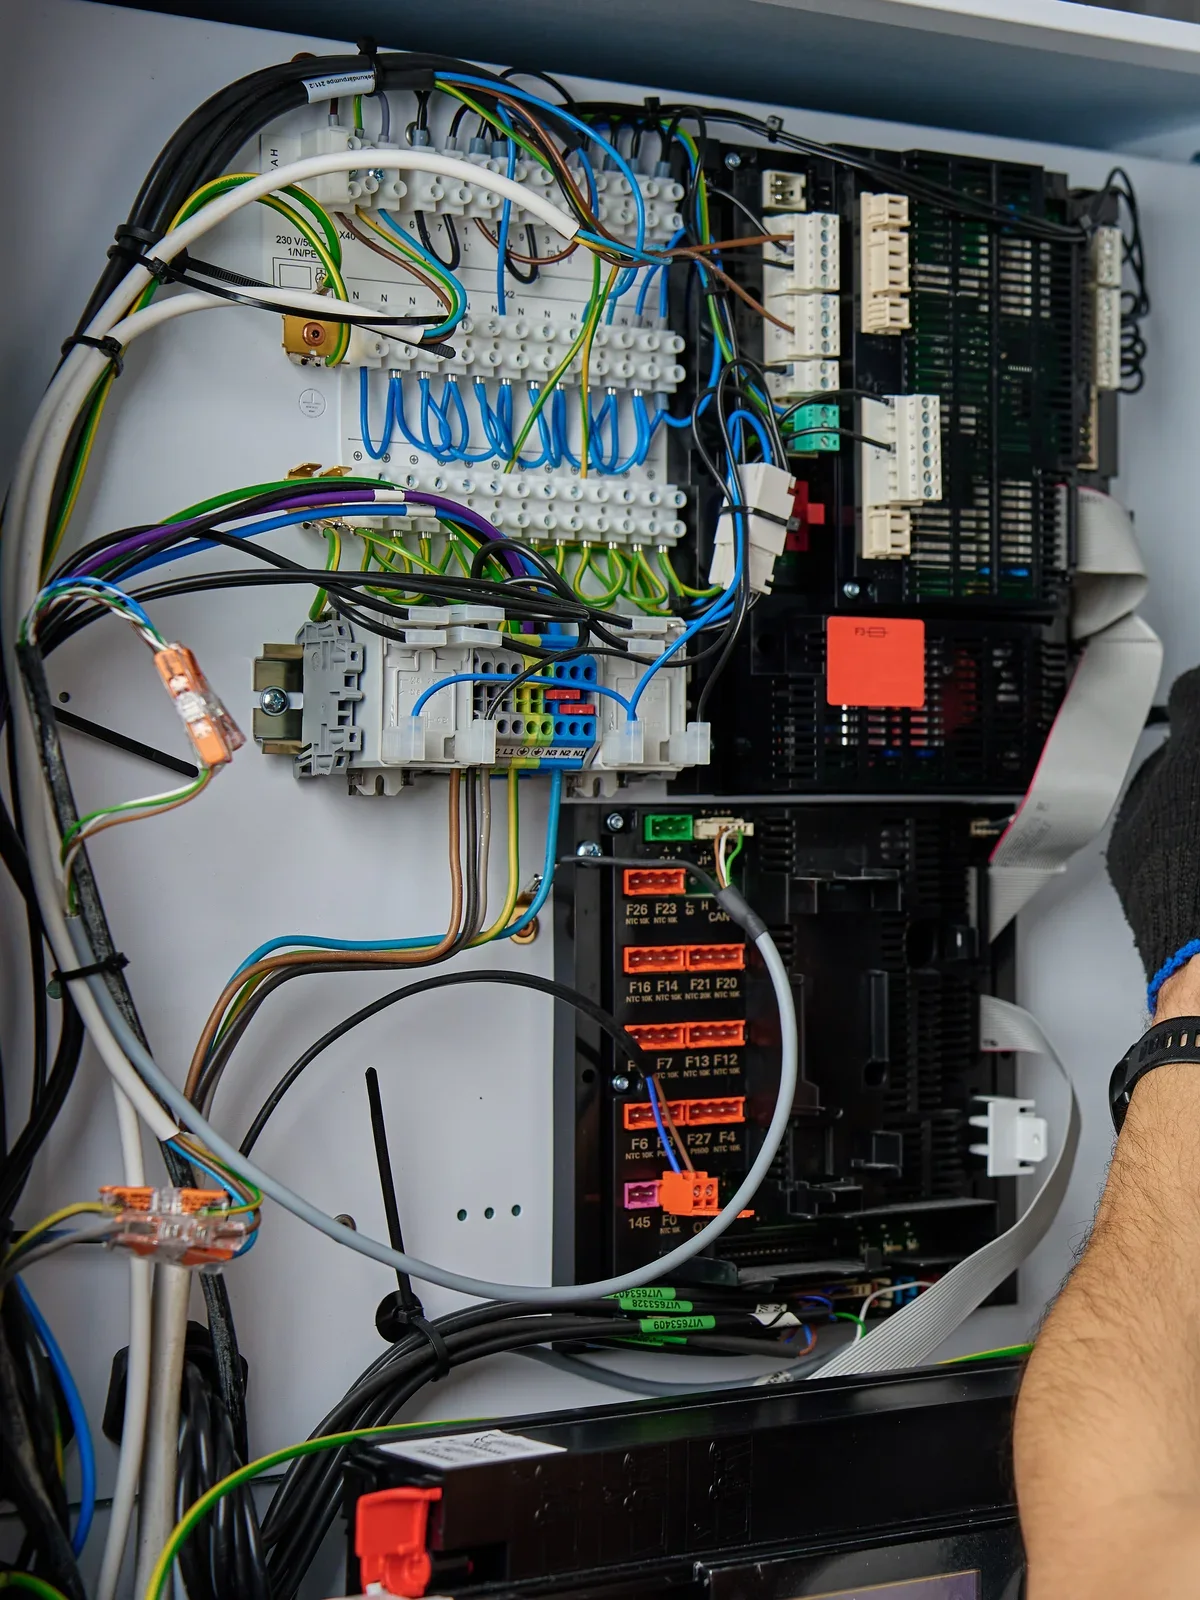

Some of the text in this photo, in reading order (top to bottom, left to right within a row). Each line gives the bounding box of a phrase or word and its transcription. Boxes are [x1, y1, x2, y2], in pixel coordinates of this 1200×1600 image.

[410, 220, 414, 228] 6
[545, 236, 550, 244] 3
[276, 236, 292, 244] 230
[288, 248, 316, 258] 1/N/PE
[504, 290, 515, 298] X2
[855, 626, 866, 636] F3
[626, 903, 677, 916] F26 F23
[630, 978, 737, 993] F16 F14 F21 F20
[657, 1058, 672, 1069] F7
[685, 1056, 710, 1068] F13
[714, 1054, 738, 1066] F12
[631, 1138, 648, 1150] F6
[687, 1133, 712, 1145] F27
[719, 1131, 736, 1142] F4
[628, 1216, 651, 1228] 145
[662, 1215, 677, 1226] F0
[632, 1300, 681, 1310] VI7653328
[654, 1319, 704, 1330] VI7653409
